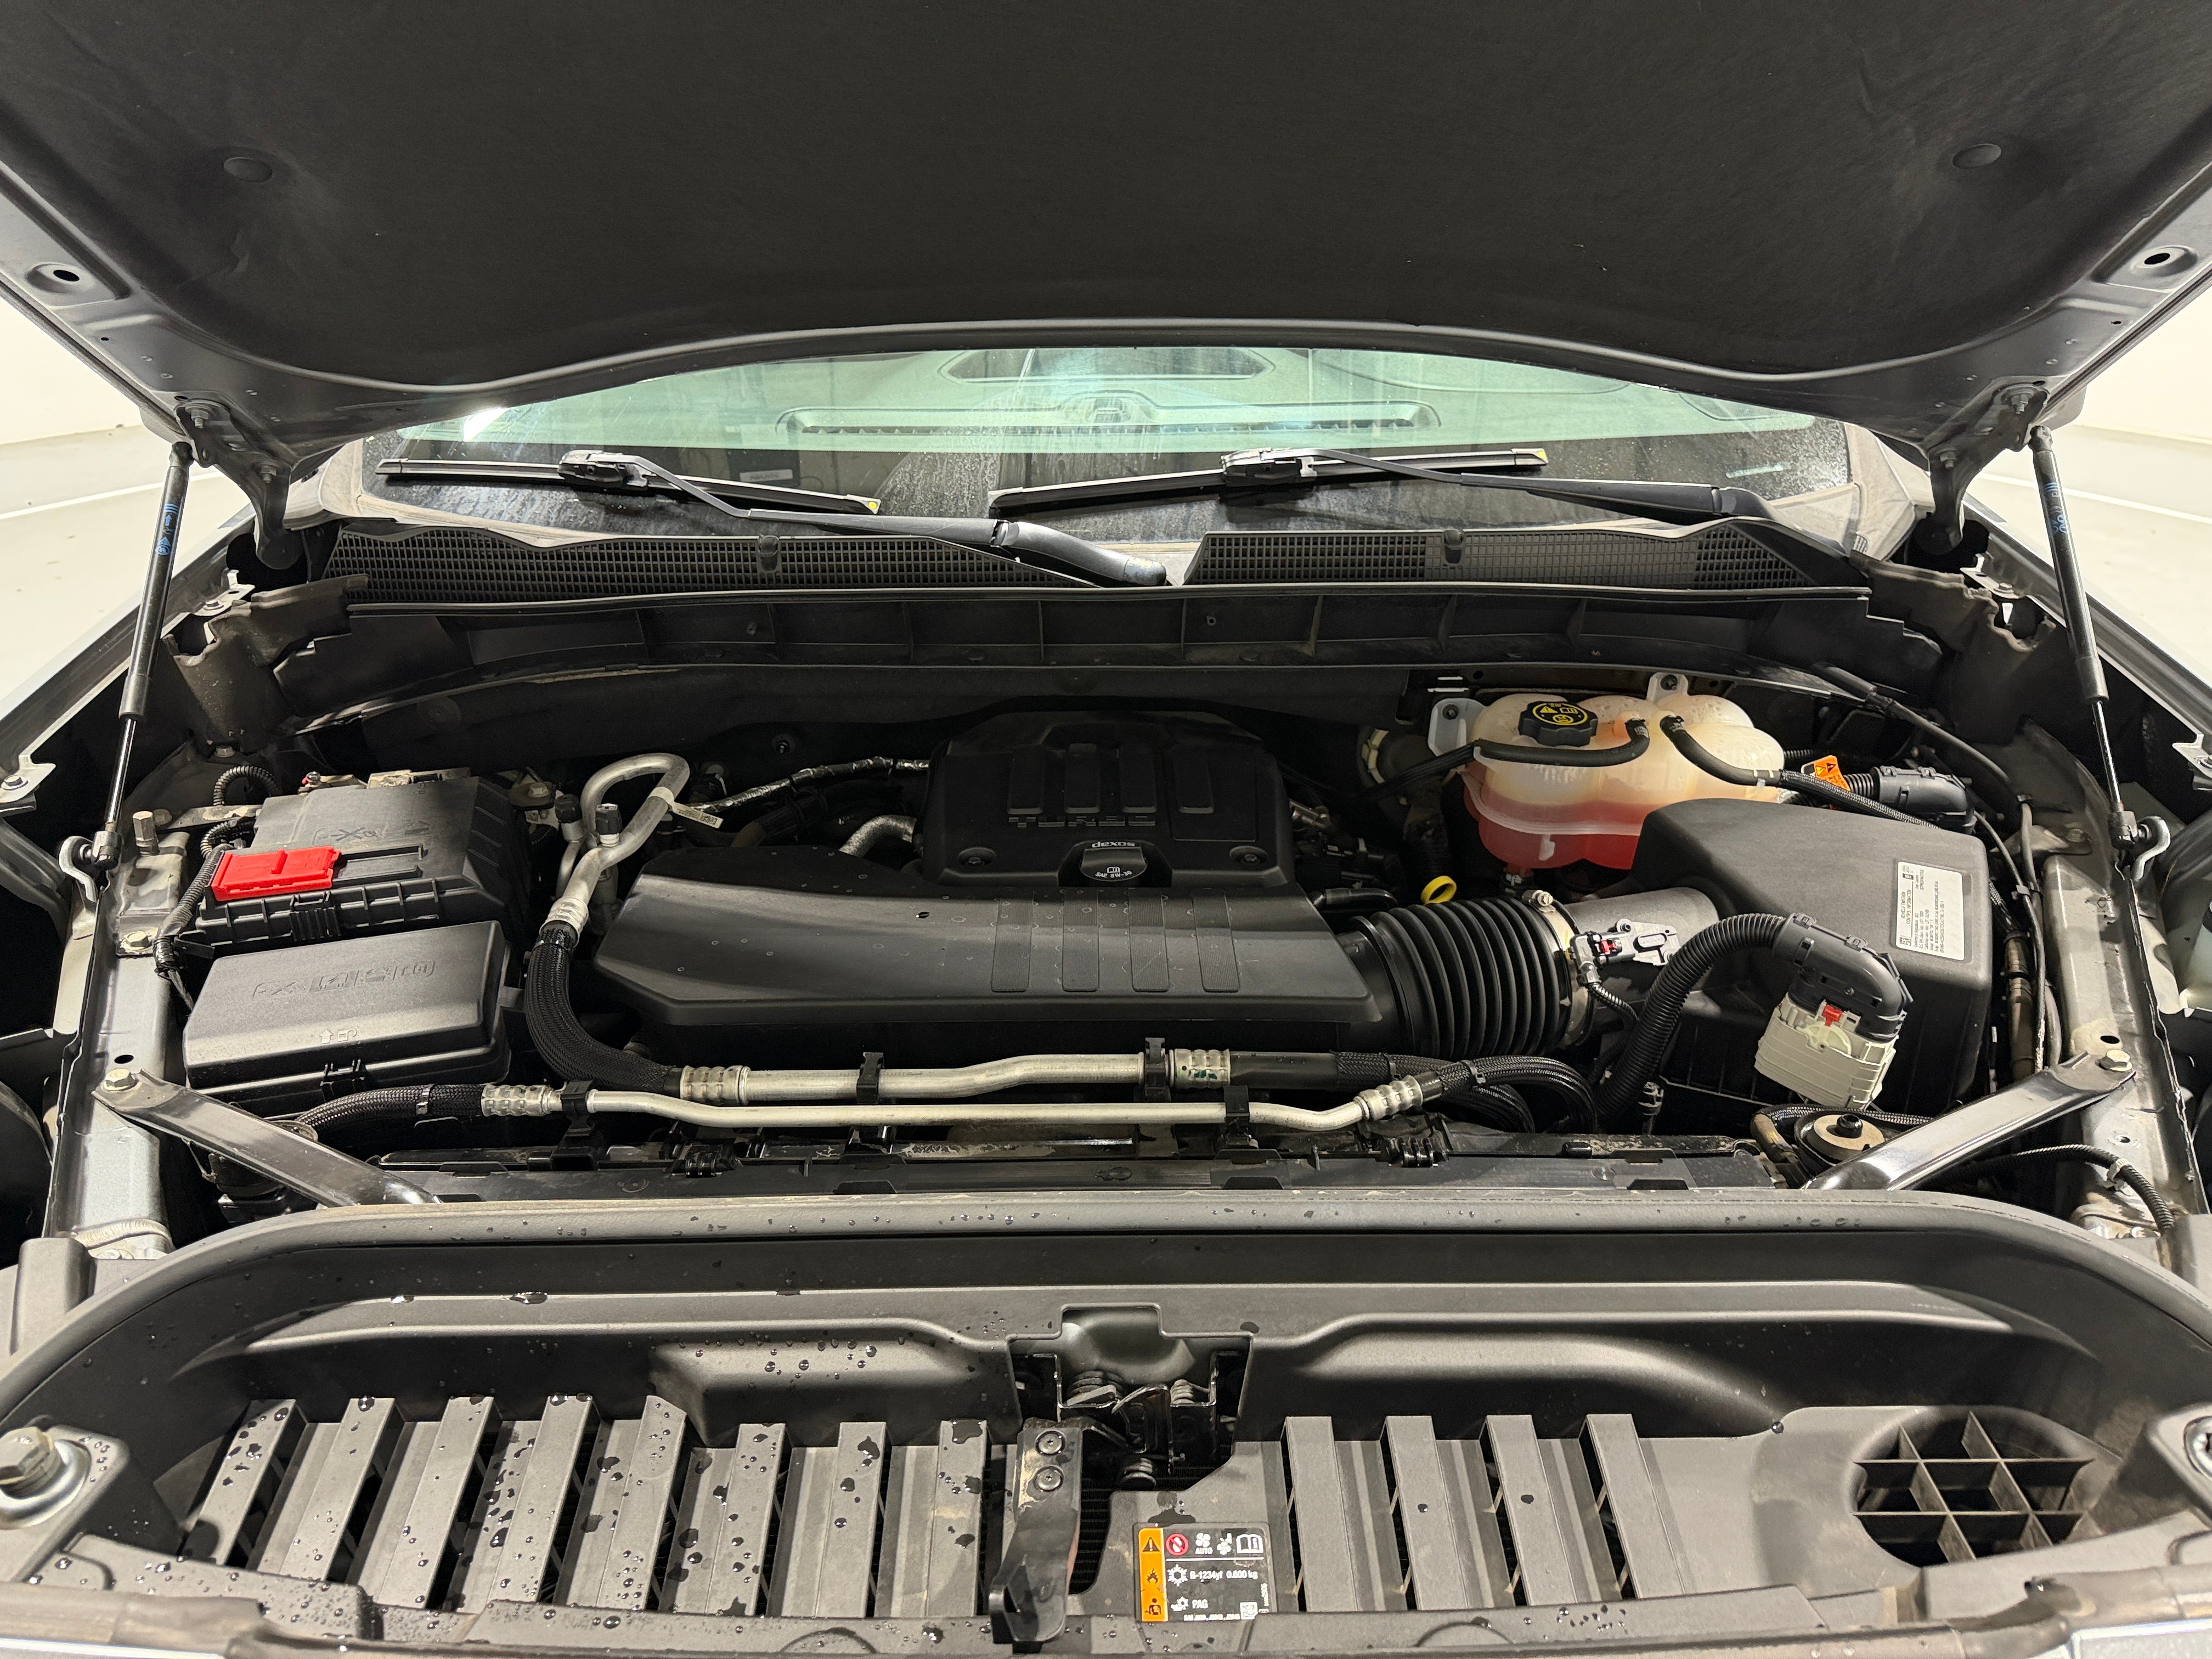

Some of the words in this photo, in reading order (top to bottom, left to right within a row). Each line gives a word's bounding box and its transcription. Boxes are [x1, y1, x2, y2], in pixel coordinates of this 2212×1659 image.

[1110, 870, 1132, 878] 5W-30
[1226, 1570, 1247, 1579] 0.600
[1248, 1570, 1258, 1579] kg
[1192, 1599, 1209, 1609] PAG
